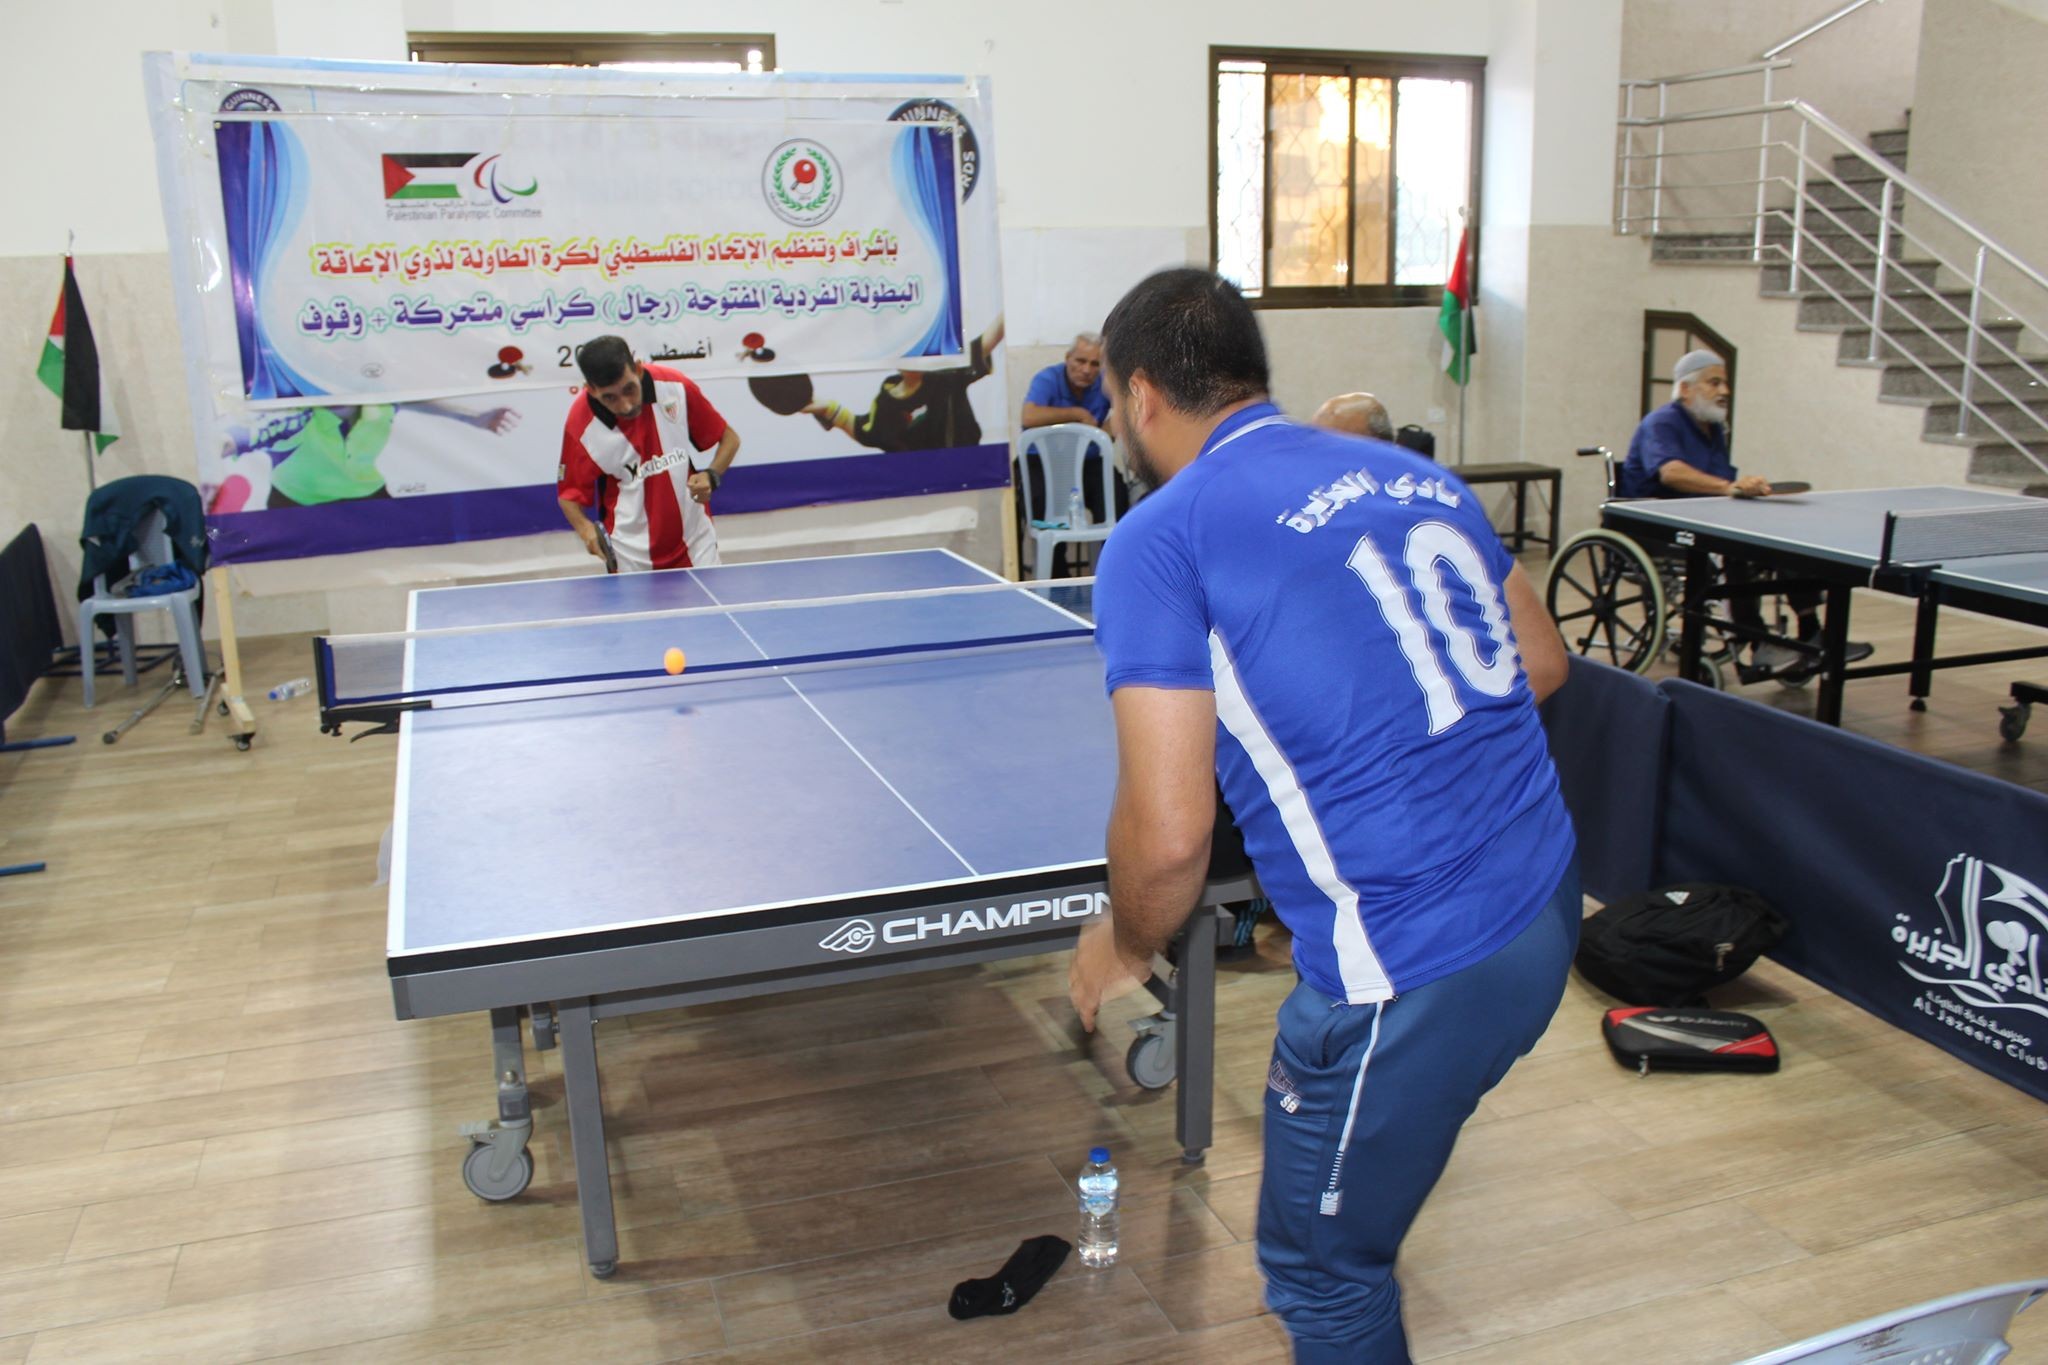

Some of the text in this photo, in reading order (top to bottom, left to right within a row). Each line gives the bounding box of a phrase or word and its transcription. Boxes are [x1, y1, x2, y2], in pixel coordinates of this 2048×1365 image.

[404, 246, 454, 280] لذوي
[460, 245, 536, 275] الطاولة
[541, 243, 600, 272] لكرة
[604, 240, 700, 277] الفلسطيني
[772, 237, 836, 264] وتنظيم
[685, 286, 766, 316] المفتوحة
[772, 283, 844, 313] الفردية
[850, 281, 920, 309] البطولة
[302, 301, 363, 336] وقوف
[394, 297, 503, 330] متحركة
[510, 293, 595, 330] كراسي
[1344, 519, 1522, 737] 10
[1279, 1095, 1299, 1114] SB
